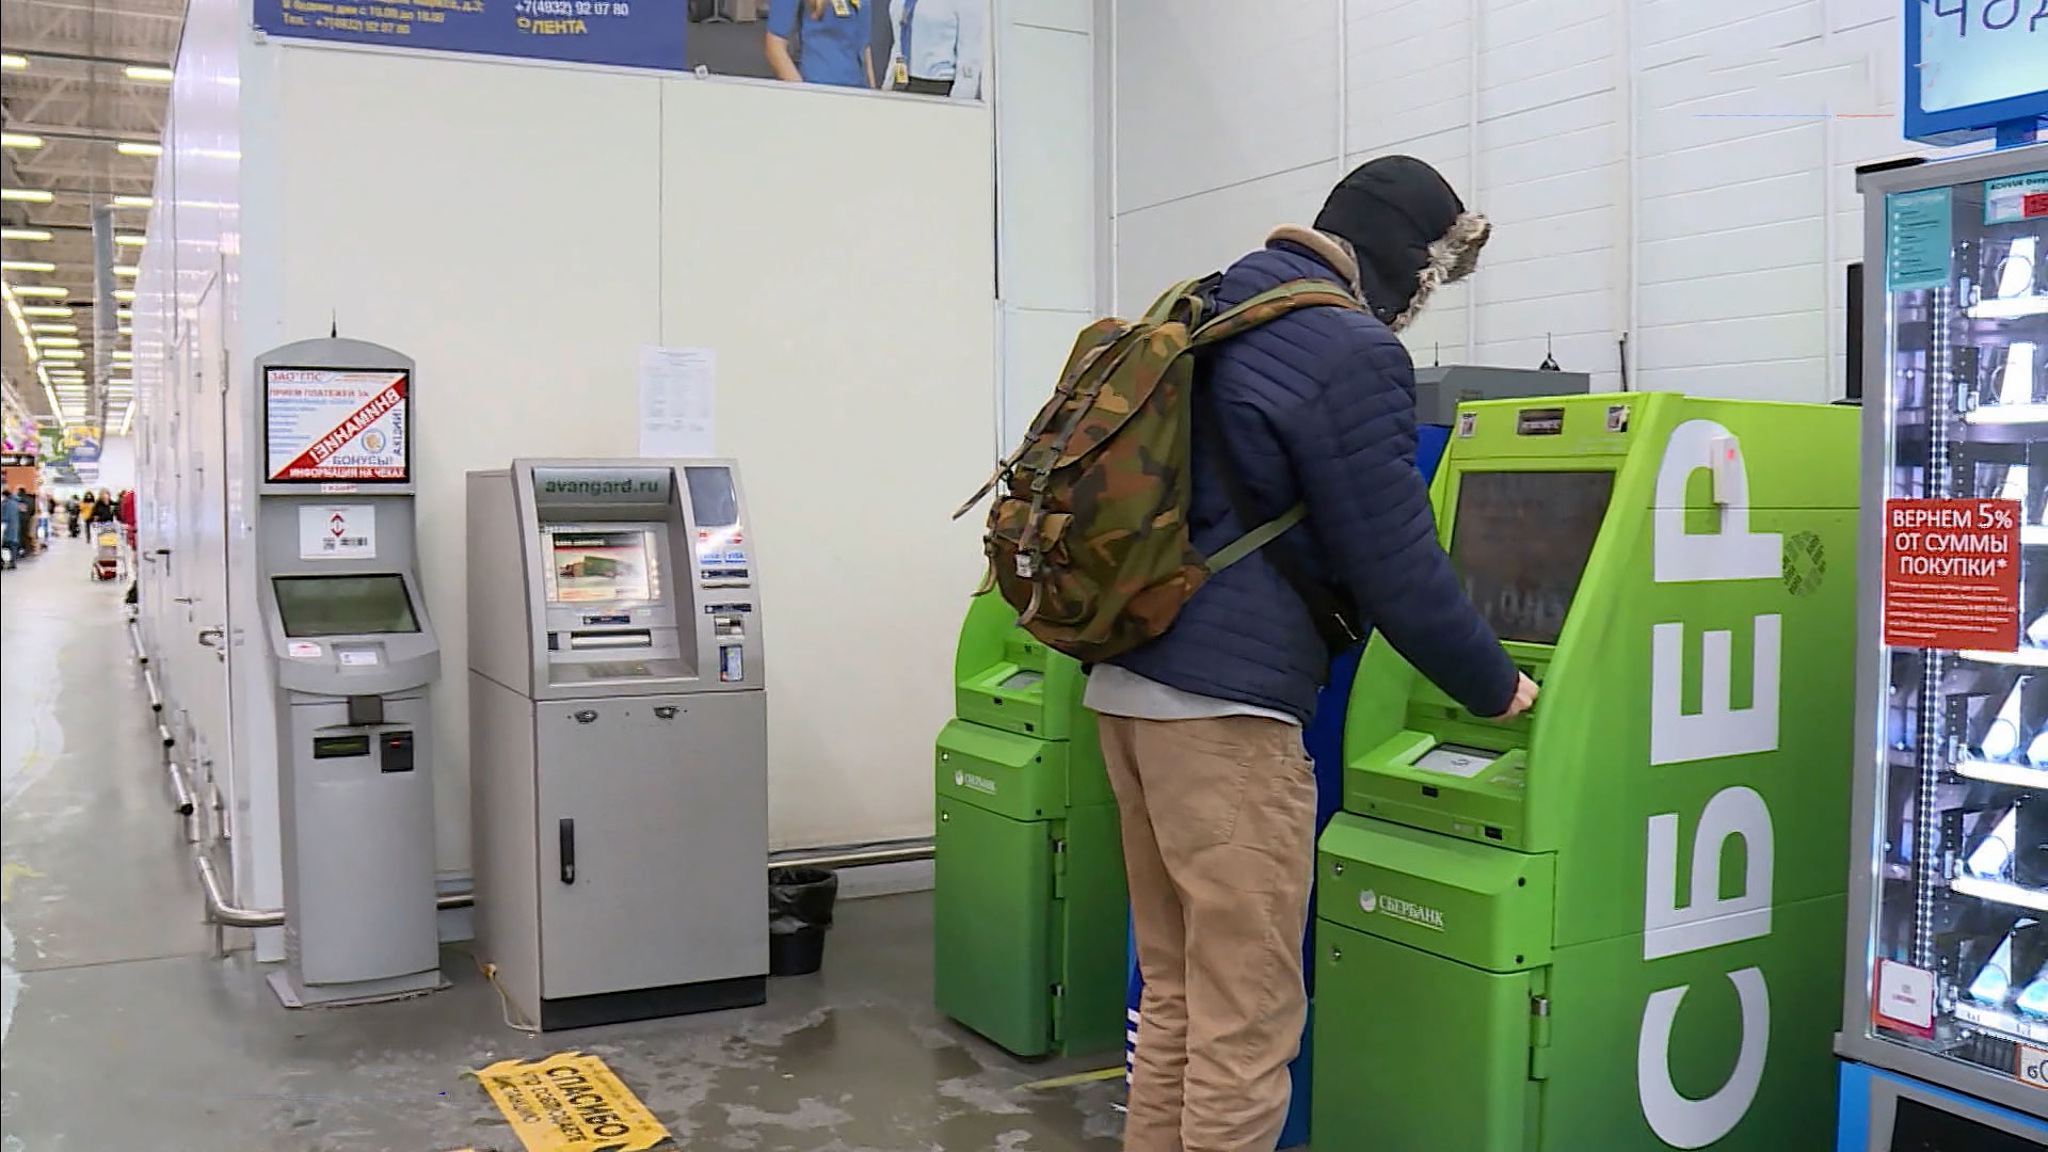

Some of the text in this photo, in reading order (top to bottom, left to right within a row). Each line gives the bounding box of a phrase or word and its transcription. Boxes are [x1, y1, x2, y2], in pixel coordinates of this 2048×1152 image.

[531, 19, 588, 34] ЛЕНТА
[545, 478, 659, 496] avangard.ru
[1893, 503, 2013, 529] ВЕРНЕМ 5%
[1895, 532, 2009, 553] ОТ СУММЫ
[1637, 419, 1784, 1149] СБЕР
[1378, 894, 1444, 927] СБЕРБАНК
